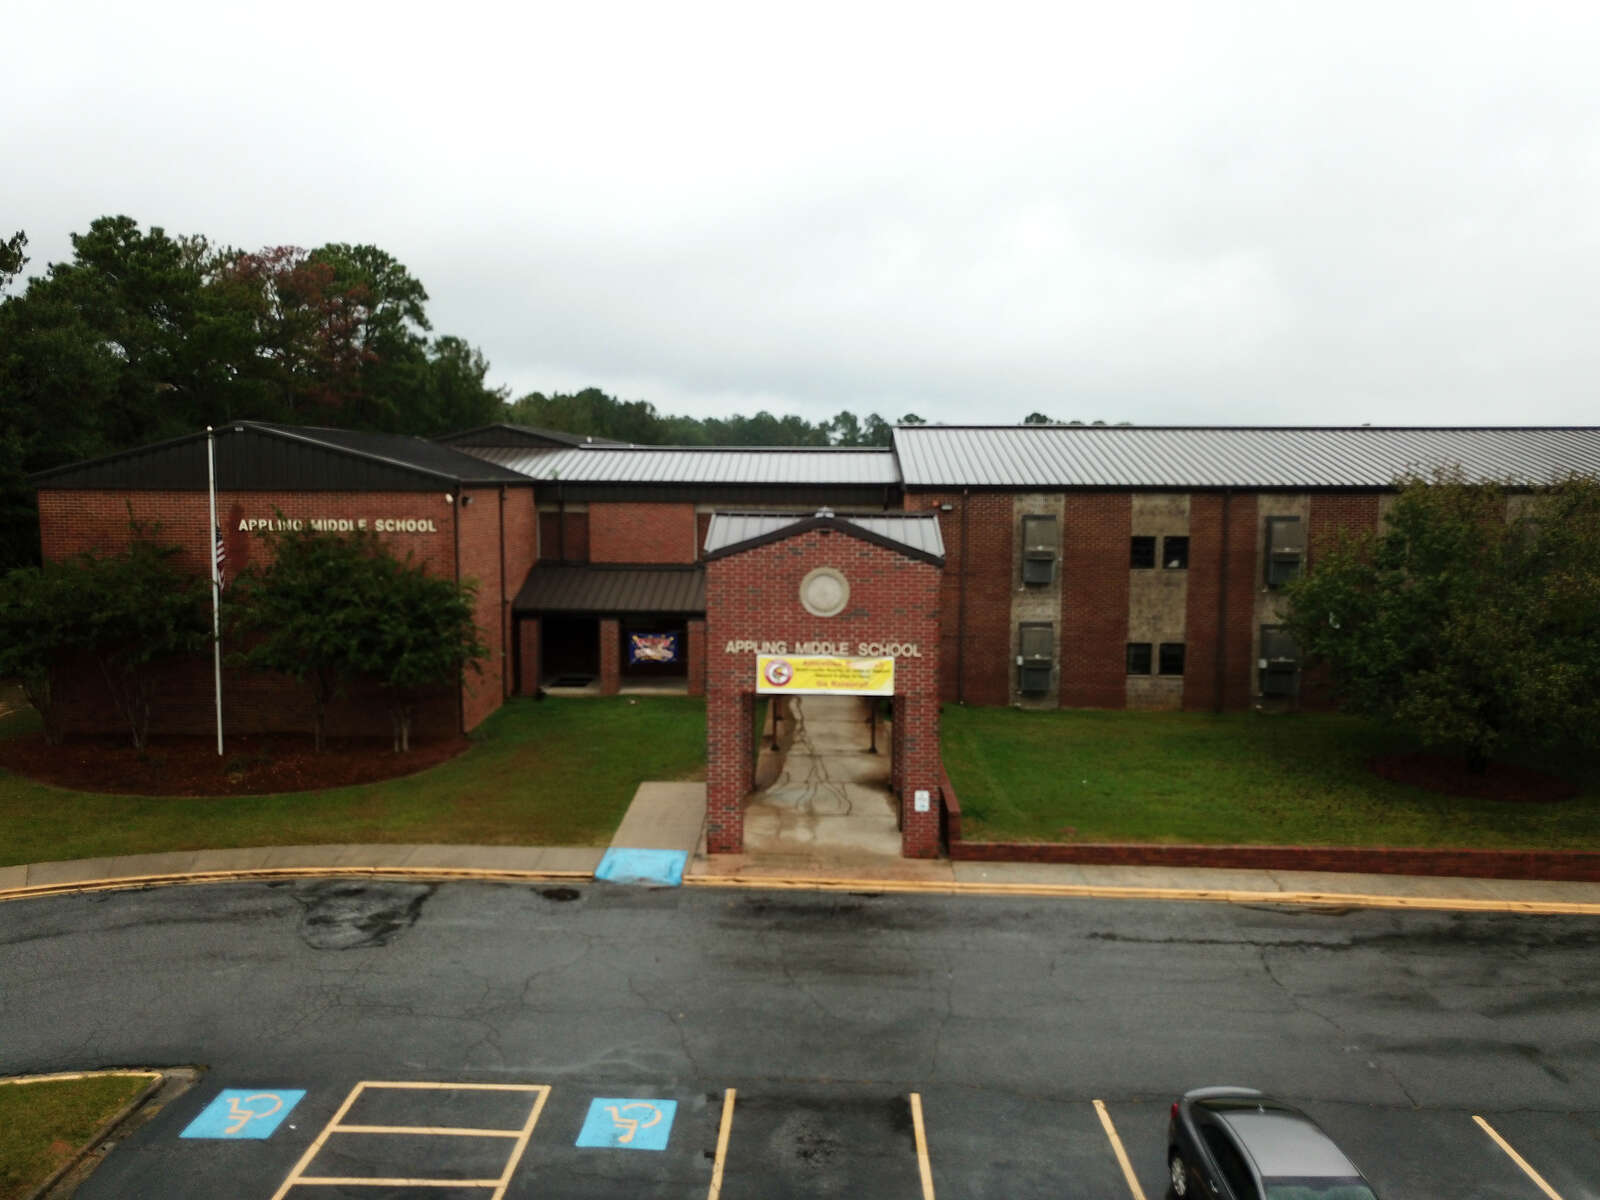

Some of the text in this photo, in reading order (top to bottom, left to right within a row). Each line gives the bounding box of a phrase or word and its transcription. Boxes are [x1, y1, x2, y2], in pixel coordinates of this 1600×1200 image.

[375, 519, 437, 532] SCHOOL
[725, 640, 922, 657] APPLING MIDDLE SCHOOL
